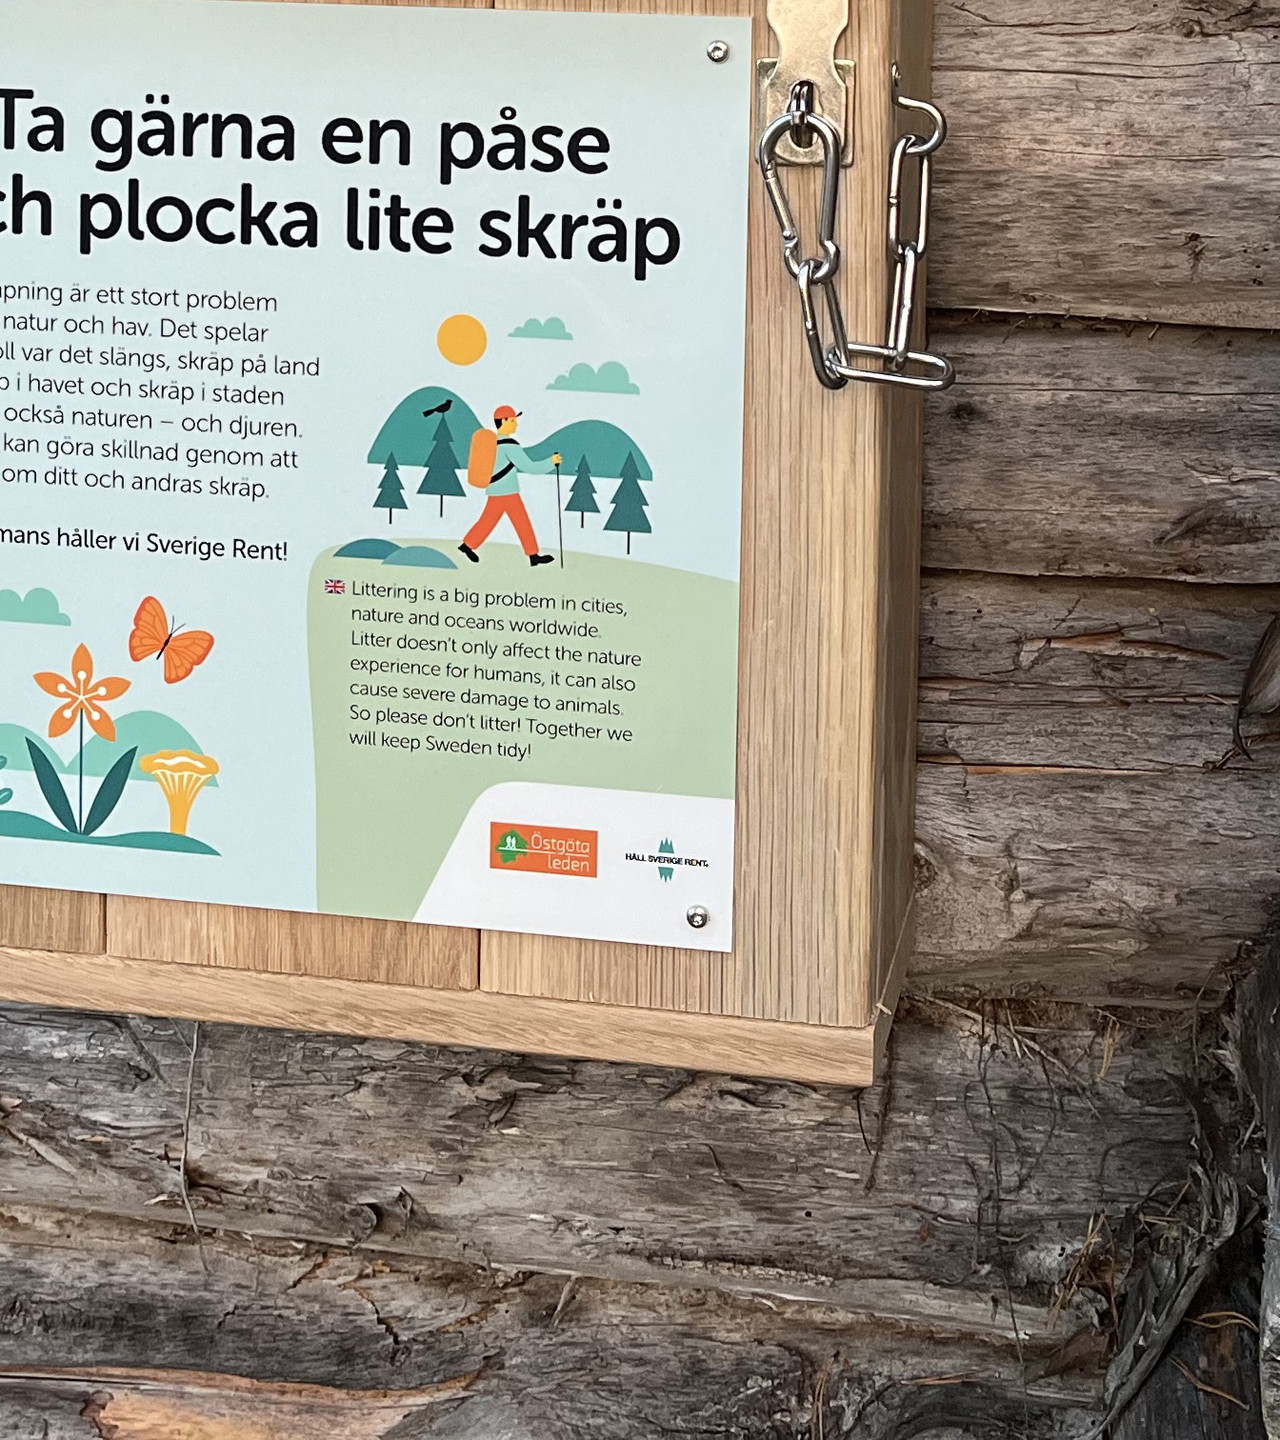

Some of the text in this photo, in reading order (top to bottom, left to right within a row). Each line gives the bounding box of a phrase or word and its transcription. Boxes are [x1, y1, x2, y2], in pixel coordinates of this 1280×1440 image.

[91, 94, 295, 172] gärna
[322, 118, 410, 166] en
[440, 106, 610, 185] påse
[80, 178, 318, 255] plocka
[347, 187, 454, 254] lite
[479, 195, 680, 281] skräp
[70, 283, 90, 302] är
[97, 287, 124, 304] ett
[131, 288, 179, 307] stort
[187, 290, 277, 313] problem
[4, 313, 58, 331] natur
[64, 315, 104, 334] och
[113, 316, 152, 336] hav.
[161, 318, 197, 339] Det
[204, 322, 269, 345] spelar
[22, 347, 53, 362] var
[60, 344, 93, 364] det
[99, 347, 170, 372] slängs,
[178, 351, 233, 376] skräp
[242, 354, 266, 377] på
[275, 355, 319, 376] land
[17, 372, 20, 391] i
[29, 373, 84, 394] havet
[91, 378, 131, 397] och
[139, 380, 194, 405] skräp
[202, 382, 205, 401] i
[212, 385, 283, 405] staden
[4, 404, 64, 424] också
[72, 409, 152, 429] naturen
[182, 414, 222, 433] och
[230, 415, 302, 440] djuren.
[4, 432, 39, 453] kan
[47, 436, 93, 459] göra
[101, 439, 178, 461] skillnad
[186, 448, 263, 468] genom
[270, 450, 298, 468] att
[2, 468, 37, 483] om
[44, 466, 78, 486] ditt
[85, 470, 124, 489] och
[132, 473, 202, 494] andras
[209, 476, 269, 502] skräp.
[58, 527, 117, 549] håller
[123, 532, 139, 551] vi
[147, 533, 225, 561] Sverige
[233, 539, 287, 561] Rent!
[352, 581, 627, 617] Littering is a big problem in cities,
[352, 608, 602, 637] nature and oceans worldwide.
[352, 630, 392, 648] Litter
[462, 640, 498, 659] only
[503, 642, 550, 659] affect
[555, 646, 582, 662] the
[588, 651, 641, 666] nature
[350, 658, 635, 691] experience for humans, it can also
[350, 684, 623, 715] cause severe damage to animals.
[350, 705, 371, 720] So
[376, 707, 428, 725] please
[481, 715, 520, 732] litter!
[525, 718, 602, 739] Together
[607, 728, 633, 741] we
[349, 730, 531, 761] will keep Sweden tidy!
[531, 831, 590, 854] Östgöta
[548, 855, 589, 872] leden
[648, 855, 683, 865] SVERIGE
